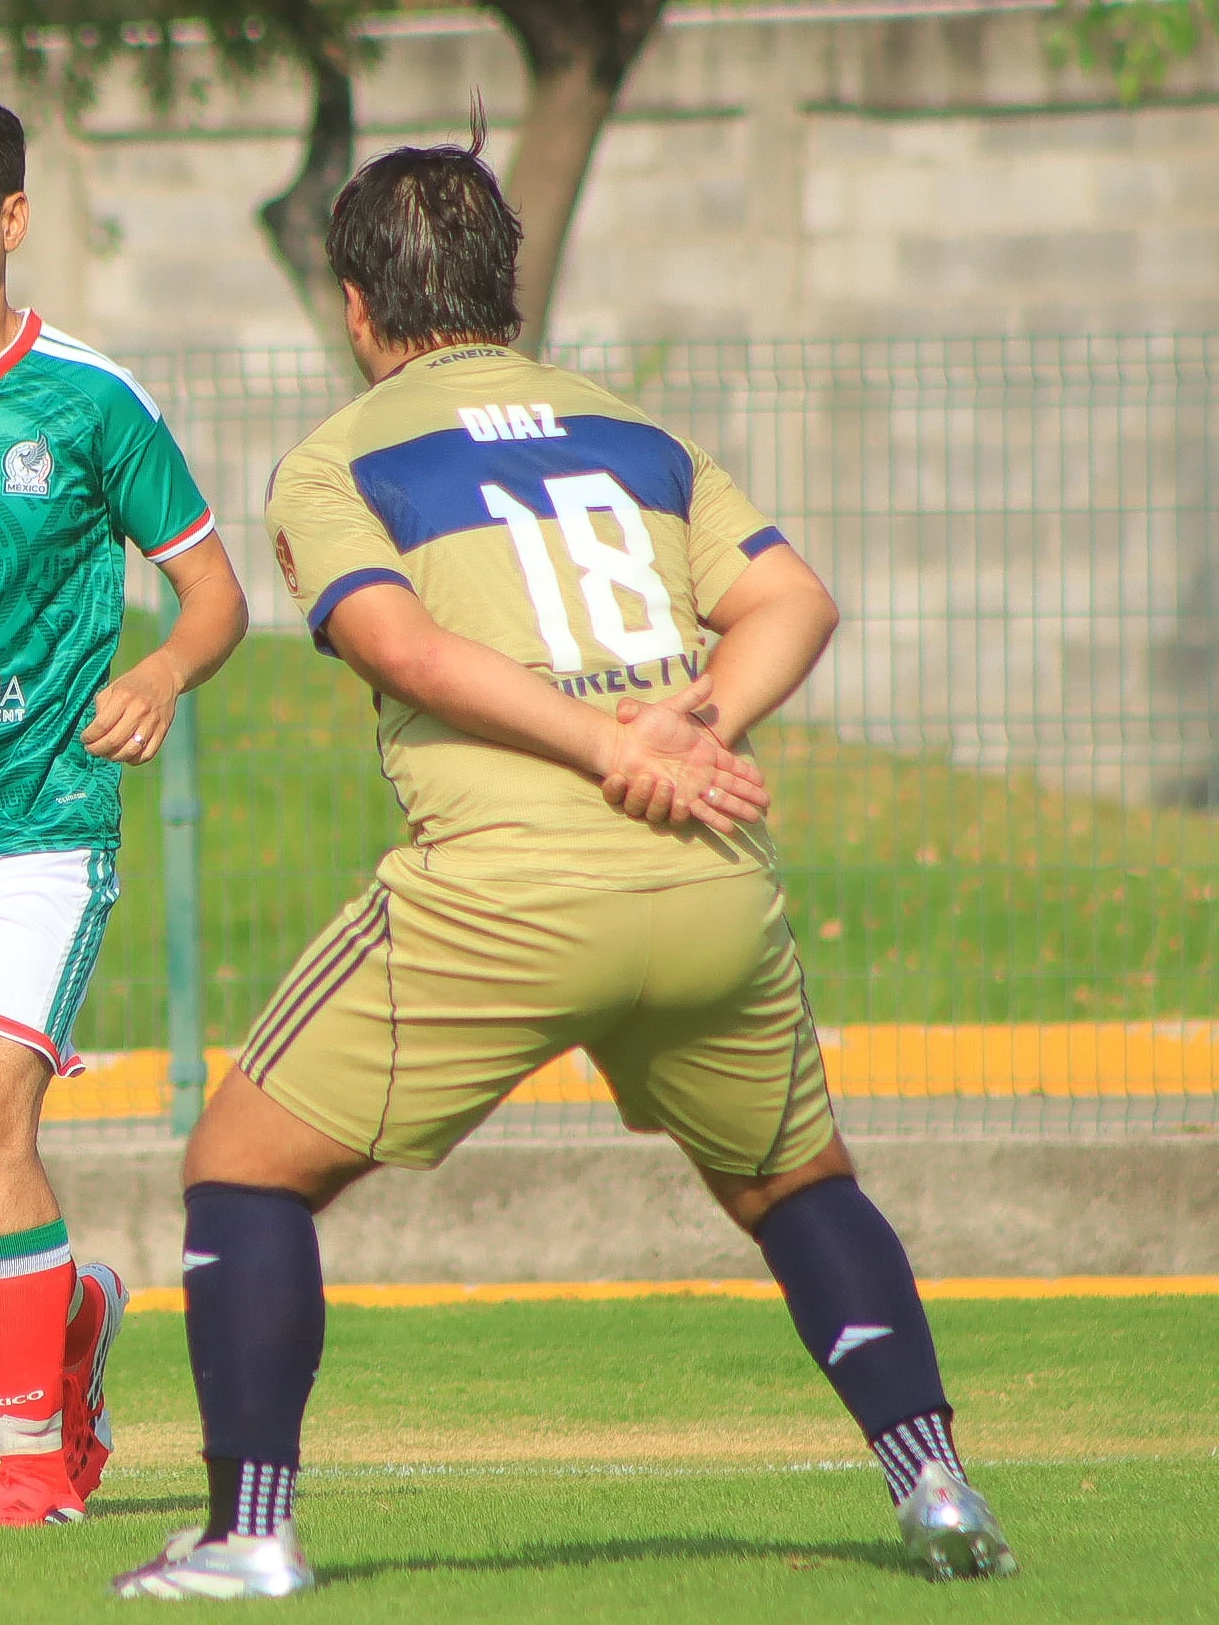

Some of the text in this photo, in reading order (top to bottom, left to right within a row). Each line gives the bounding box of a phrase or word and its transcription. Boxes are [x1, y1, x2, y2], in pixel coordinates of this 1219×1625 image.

[426, 349, 507, 369] XENEIZE
[457, 403, 568, 442] DIAZ
[481, 473, 684, 672] 18
